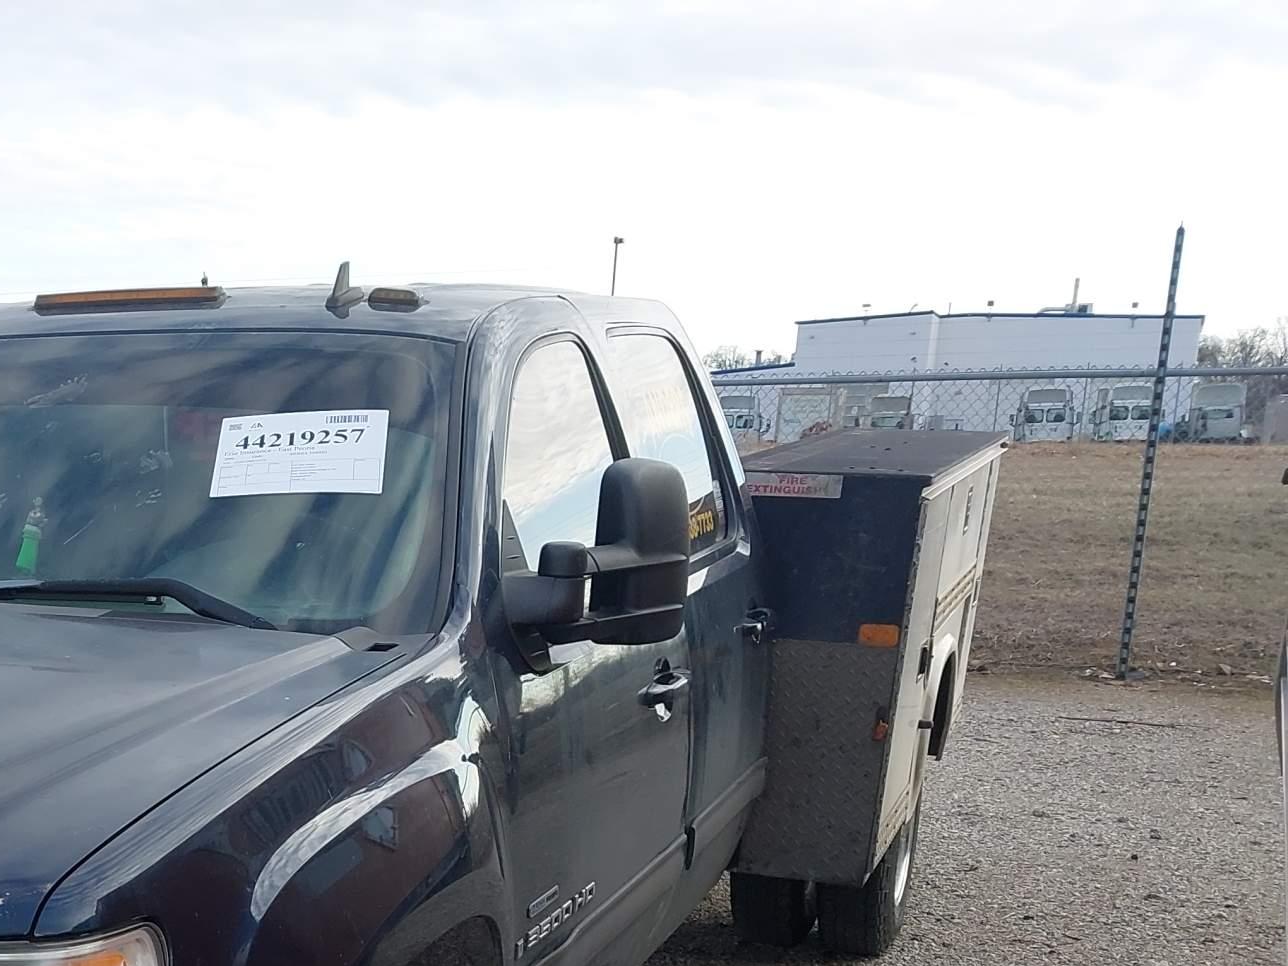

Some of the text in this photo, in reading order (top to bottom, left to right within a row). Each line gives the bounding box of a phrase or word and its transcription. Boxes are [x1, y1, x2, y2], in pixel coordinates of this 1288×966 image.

[235, 428, 366, 450] 44219257
[776, 475, 809, 485] FIRE
[527, 900, 573, 949] 3500
[575, 881, 596, 913] HD
